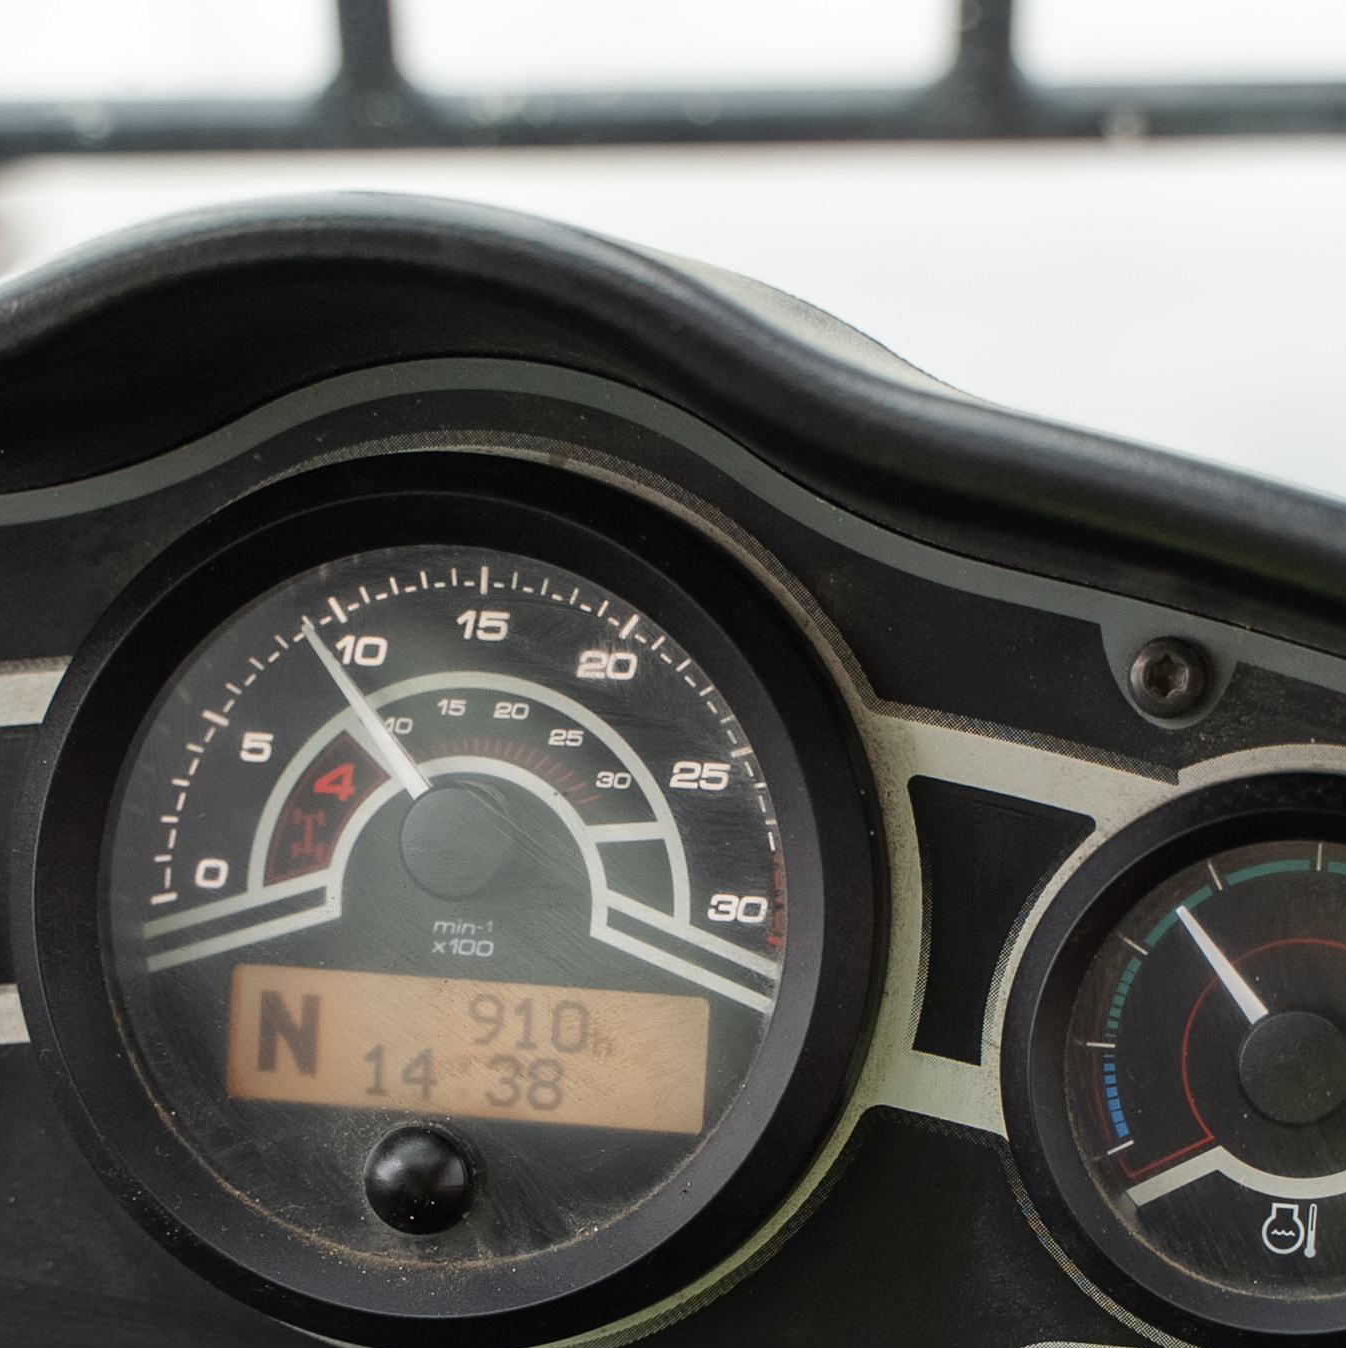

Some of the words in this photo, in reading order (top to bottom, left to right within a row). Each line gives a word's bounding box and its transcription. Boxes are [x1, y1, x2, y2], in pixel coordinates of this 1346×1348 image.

[456, 610, 509, 641] 15
[335, 636, 387, 667] 10
[576, 651, 638, 681] 20
[437, 699, 467, 717] 15
[493, 702, 529, 720] 20
[240, 733, 273, 763] 5
[548, 728, 584, 748] 25
[313, 763, 355, 801] 4
[596, 770, 632, 790] 30
[669, 761, 732, 791] 25
[194, 858, 228, 888] 0
[707, 894, 768, 924] 30
[431, 938, 495, 957] x100
[257, 990, 321, 1078] N
